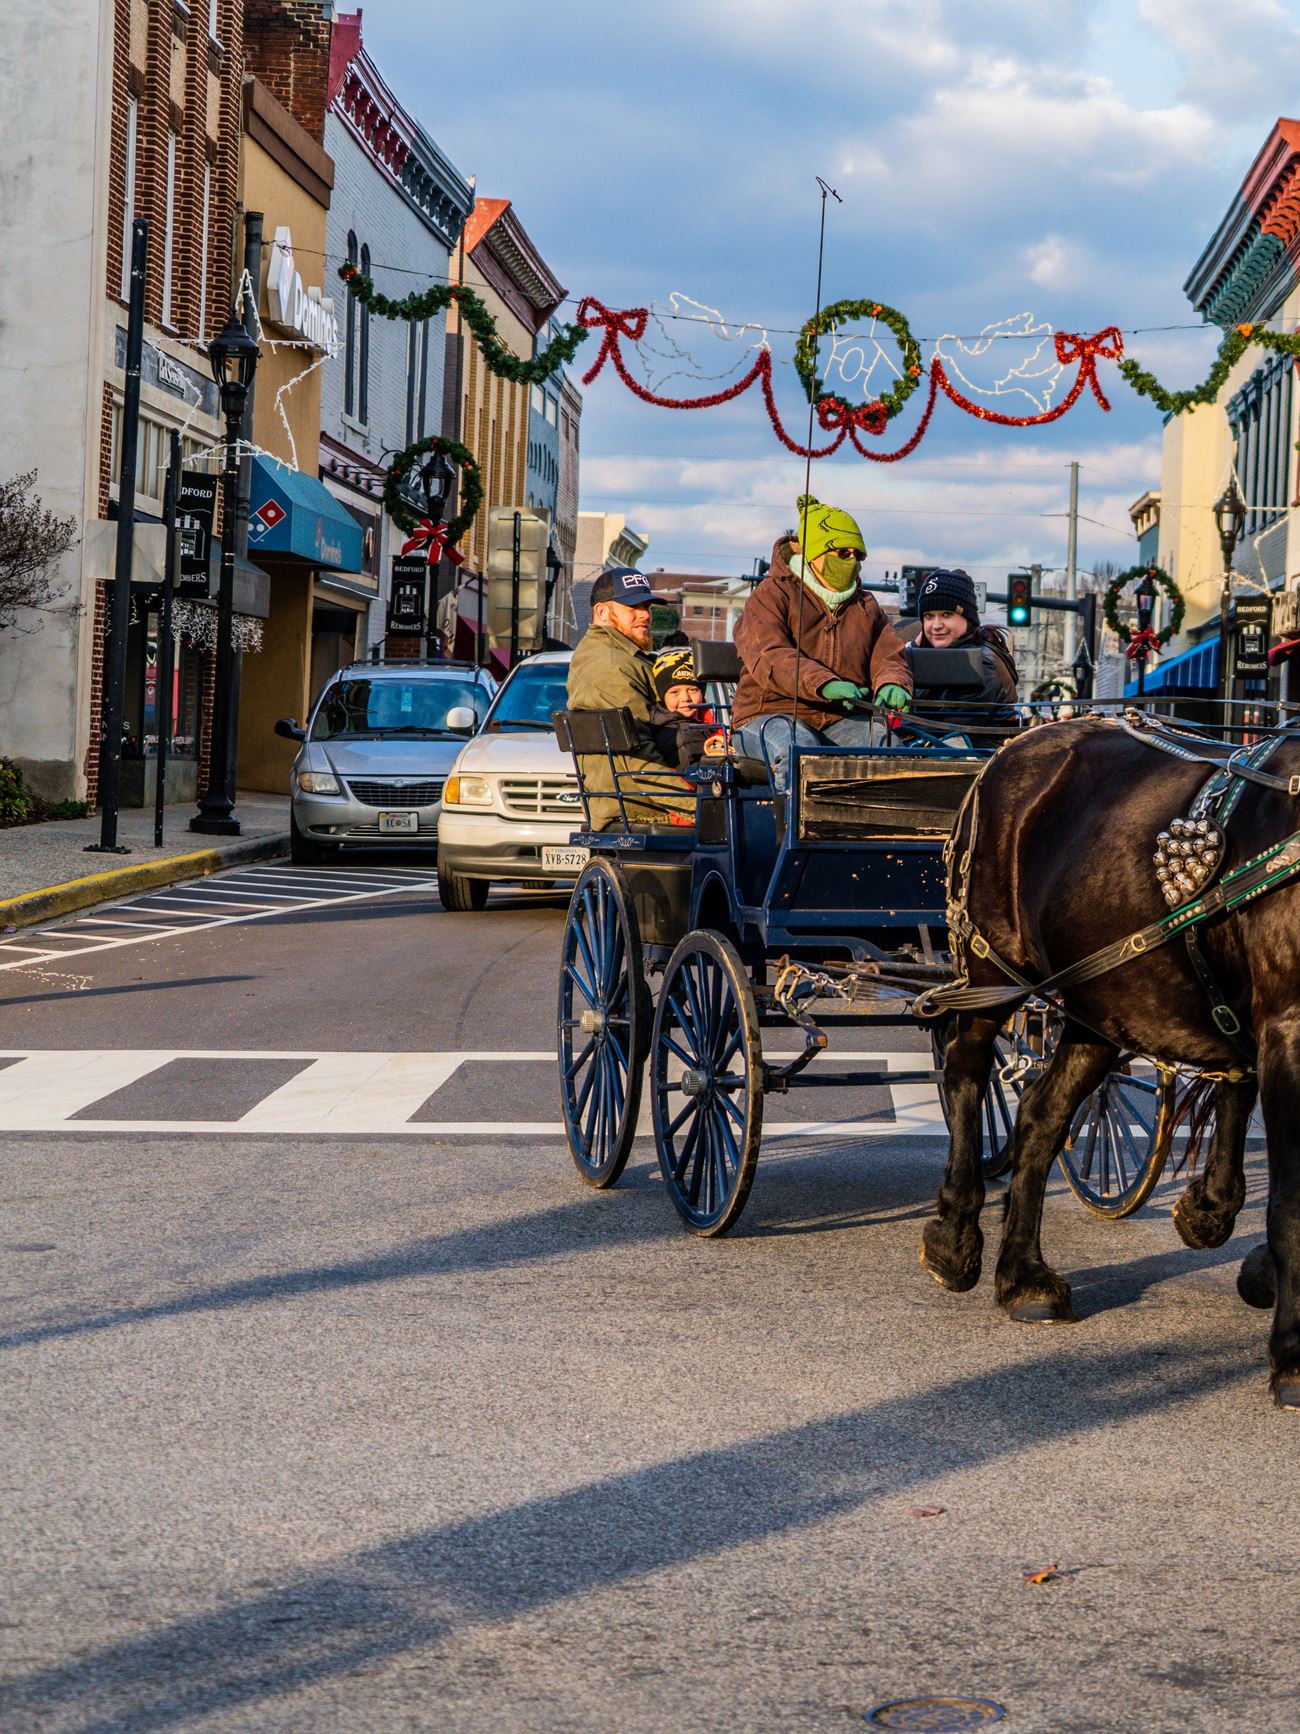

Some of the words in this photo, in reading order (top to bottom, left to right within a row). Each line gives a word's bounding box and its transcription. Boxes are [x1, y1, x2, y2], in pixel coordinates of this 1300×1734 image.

[181, 486, 213, 499] DFORD
[394, 565, 425, 573] BEDFORD
[180, 571, 207, 583] EMBERS
[545, 853, 587, 865] XVB-5728
